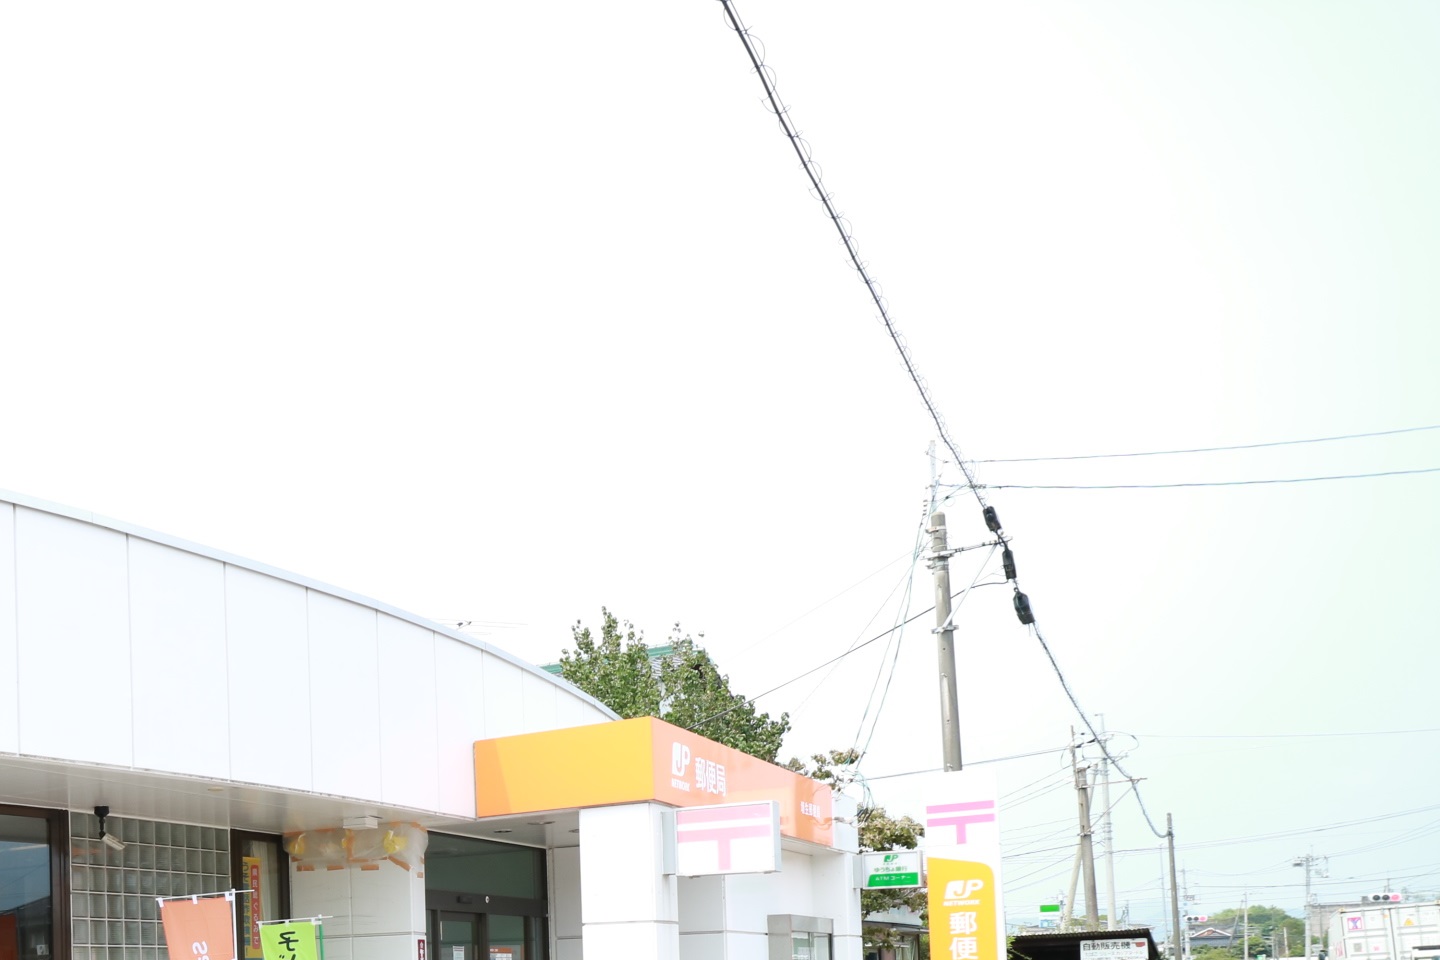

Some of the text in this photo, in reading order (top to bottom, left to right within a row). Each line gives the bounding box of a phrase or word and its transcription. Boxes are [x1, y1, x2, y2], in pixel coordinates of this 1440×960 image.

[672, 742, 691, 777] JP
[695, 757, 727, 797] 郵便局
[883, 854, 899, 863] JP
[874, 865, 908, 873] ゆうちょ銀行
[943, 879, 984, 900] JP
[942, 899, 982, 907] NETWORK
[1082, 941, 1131, 952] 自動販売機
